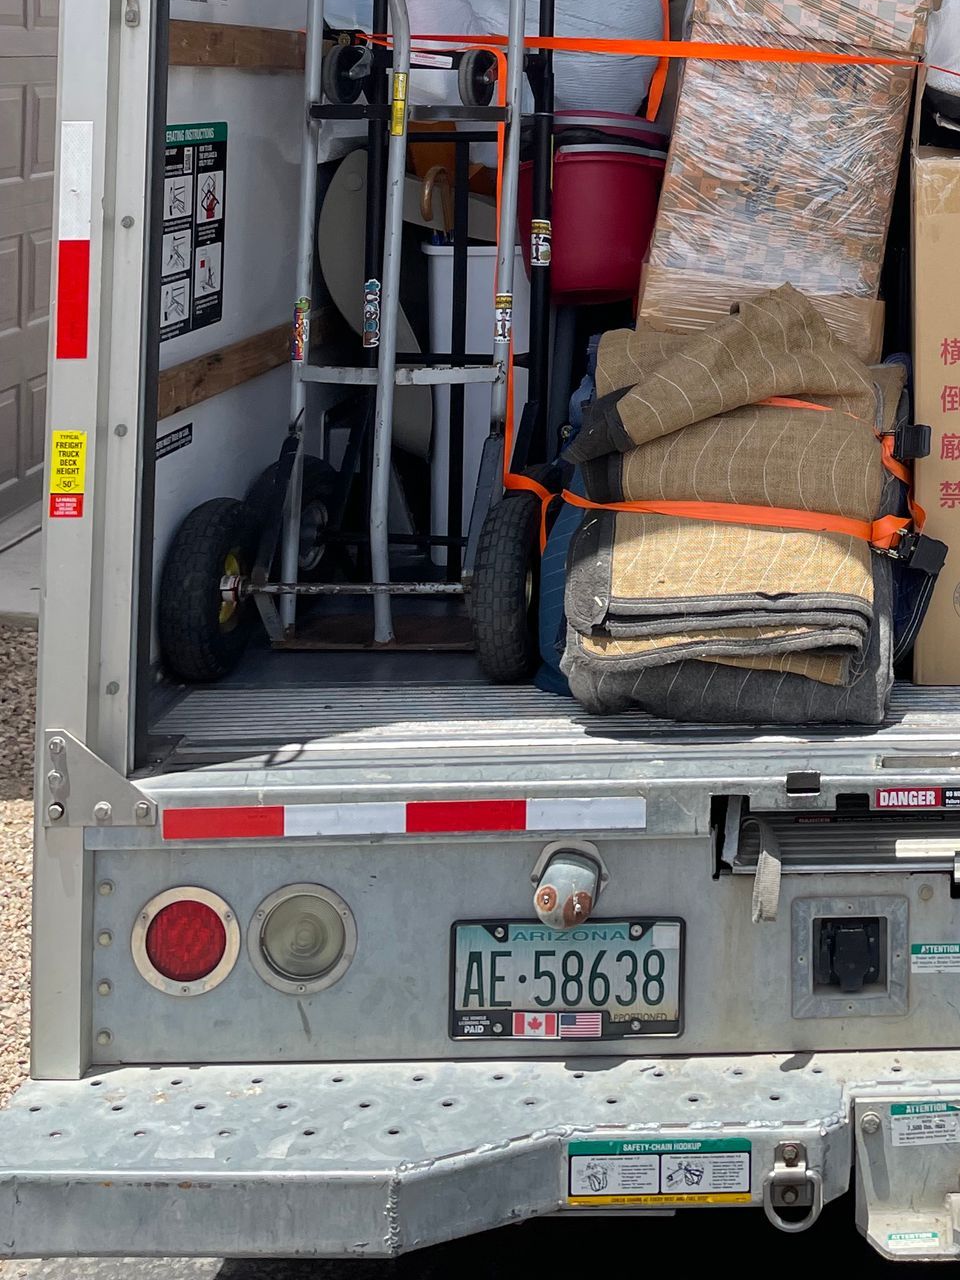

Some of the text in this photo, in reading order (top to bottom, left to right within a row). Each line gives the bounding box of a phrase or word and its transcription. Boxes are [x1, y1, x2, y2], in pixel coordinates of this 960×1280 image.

[166, 130, 184, 142] ERATING
[55, 441, 83, 449] FREIGHT
[58, 450, 79, 458] TRUCK
[60, 459, 77, 467] DECK
[880, 791, 936, 807] DANGER
[512, 930, 627, 941] ARIZONA
[921, 944, 960, 953] ATTENTION
[464, 1025, 484, 1033] PAID
[906, 1103, 947, 1113] ATTENTION
[623, 1142, 701, 1152] SAFETY-CHAIN HOOKUP
